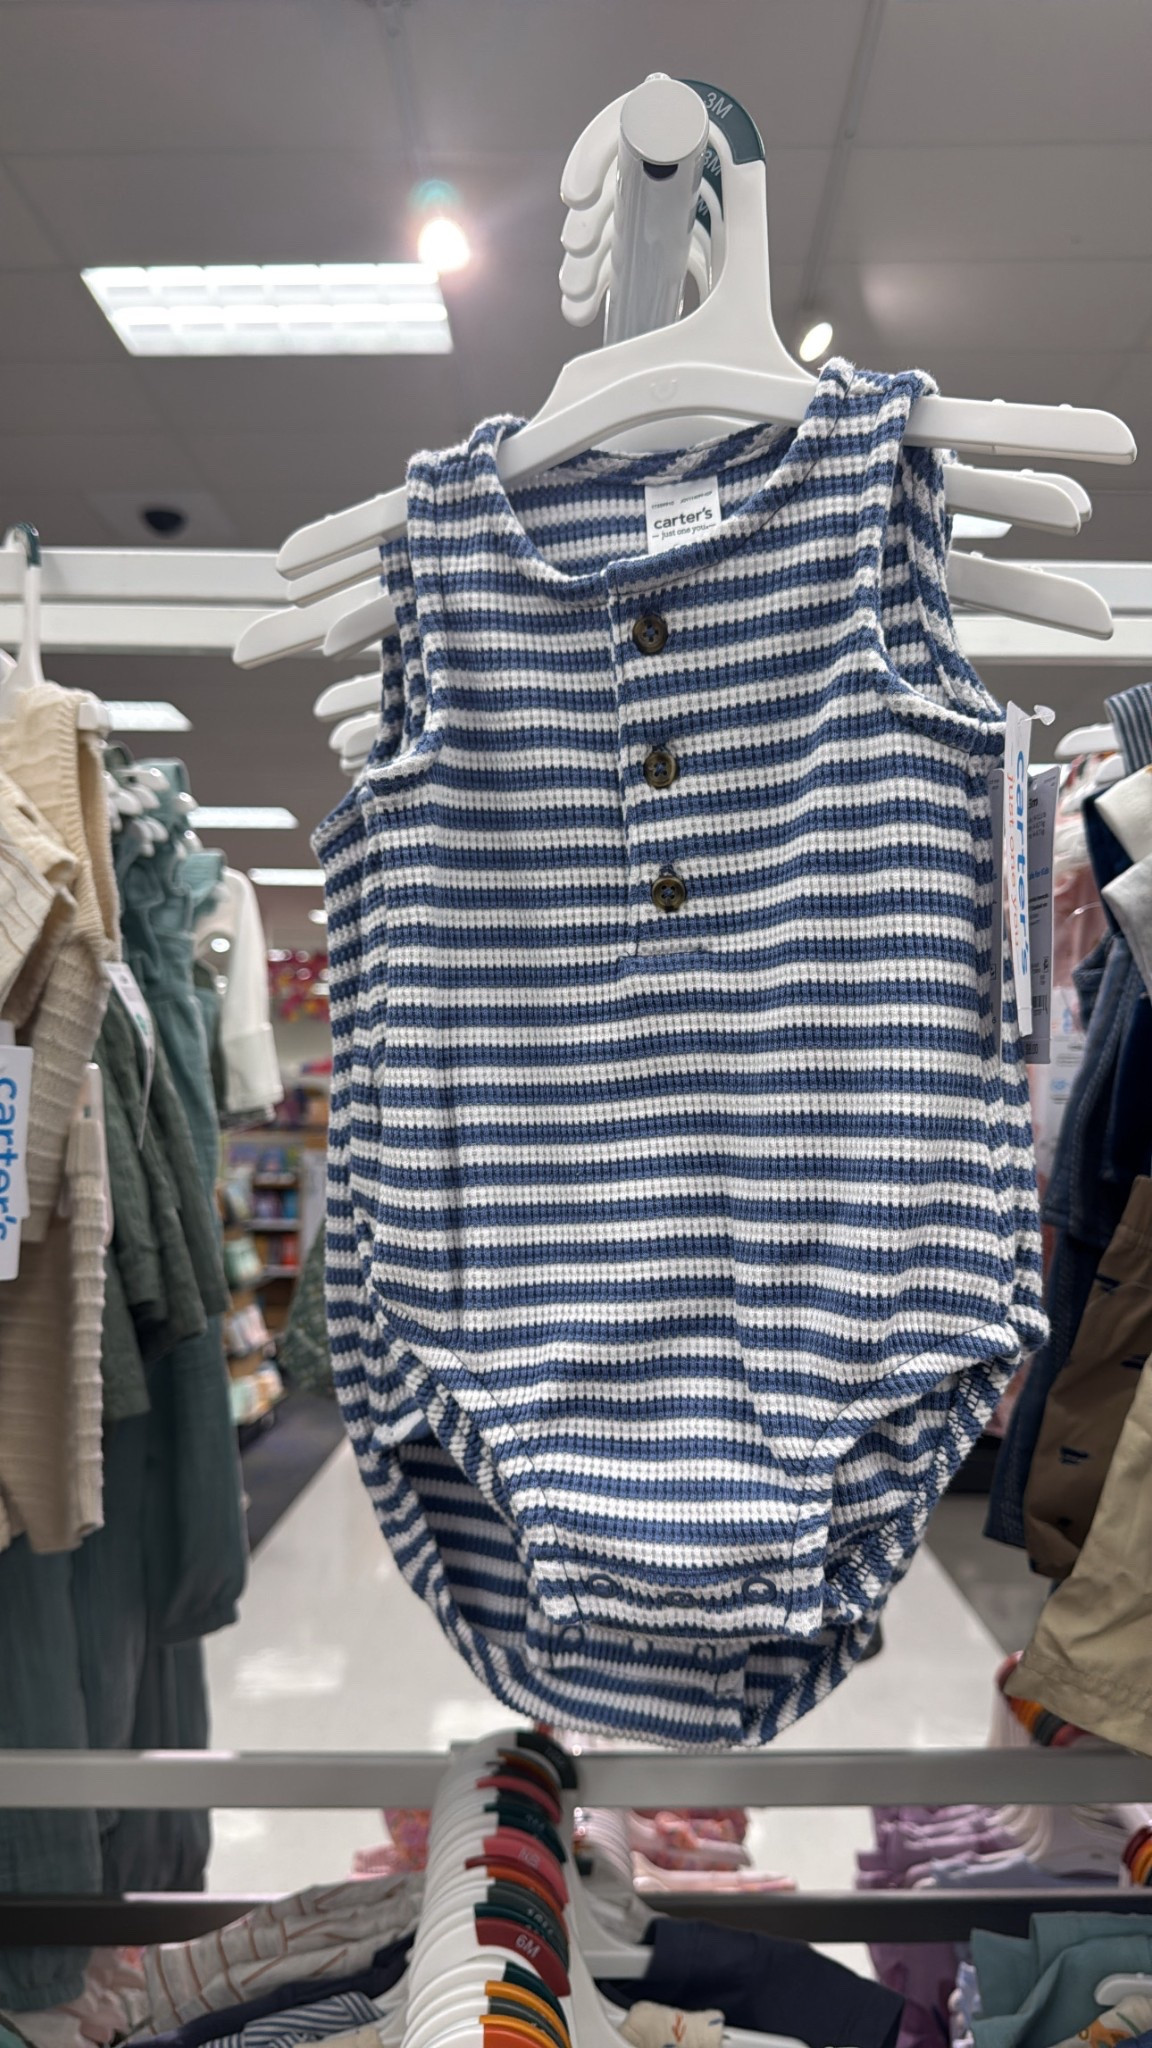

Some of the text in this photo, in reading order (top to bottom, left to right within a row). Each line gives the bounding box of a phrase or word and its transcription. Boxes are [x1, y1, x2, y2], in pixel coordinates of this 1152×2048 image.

[654, 506, 713, 530] carter's
[661, 529, 676, 541] just
[676, 527, 691, 536] one
[1007, 773, 1015, 828] just
[1016, 751, 1029, 975] carter's
[1010, 893, 1018, 946] you
[515, 1934, 541, 1958] 6M
